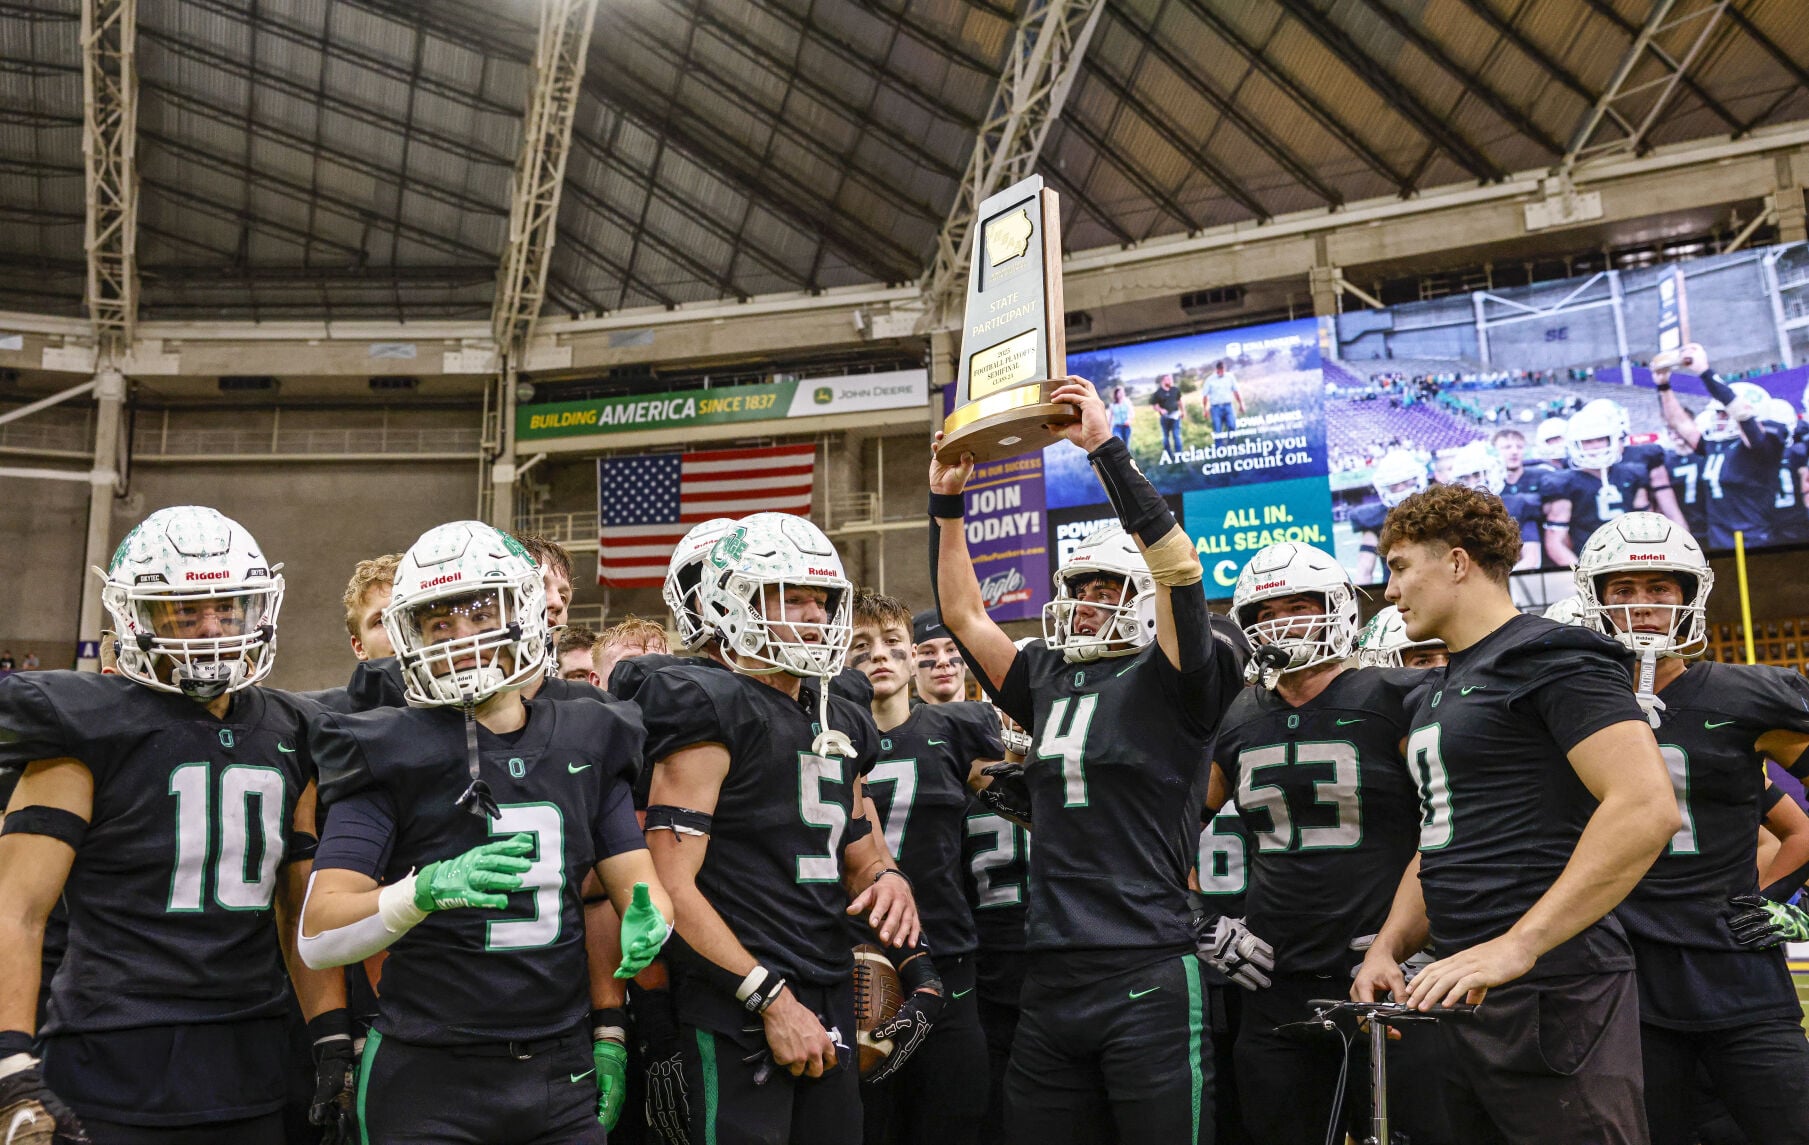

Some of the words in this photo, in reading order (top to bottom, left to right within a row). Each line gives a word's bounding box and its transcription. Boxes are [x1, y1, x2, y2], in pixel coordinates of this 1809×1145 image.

[990, 291, 1019, 313] STATE
[972, 300, 1037, 337] PARTICIPANT
[973, 359, 1005, 377] FOOTBALL
[987, 362, 1020, 380] SEMIFINAL
[838, 388, 871, 400] JOHN
[873, 385, 913, 396] DEERE
[530, 410, 597, 429] BUILDING
[598, 398, 696, 426] AMERICA
[698, 398, 741, 414] SINCE
[745, 394, 776, 410] 1837
[1159, 450, 1174, 466] A
[1173, 436, 1274, 464] relationship
[1274, 435, 1308, 456] you
[1201, 461, 1233, 476] can
[1233, 452, 1284, 472] count
[1284, 451, 1313, 465] on.
[1673, 464, 1698, 504] 7
[1702, 453, 1726, 499] 4
[968, 484, 1022, 517] JOIN
[963, 511, 1040, 544] ODAY!
[1223, 510, 1262, 530] ALL
[1264, 505, 1294, 523] IN.
[1195, 534, 1232, 556] ALL
[1234, 524, 1327, 552] SEASON.
[186, 570, 230, 581] Riddell
[420, 572, 462, 589] Riddell
[808, 567, 838, 577] Riddell
[1255, 580, 1286, 592] Riddell
[83, 642, 94, 657] A
[1037, 693, 1099, 808] 4
[866, 757, 919, 862] 7
[1237, 739, 1363, 854] 53
[796, 751, 848, 884] 5
[166, 761, 285, 913] 10
[485, 800, 566, 951] 3
[966, 812, 1031, 909] 2
